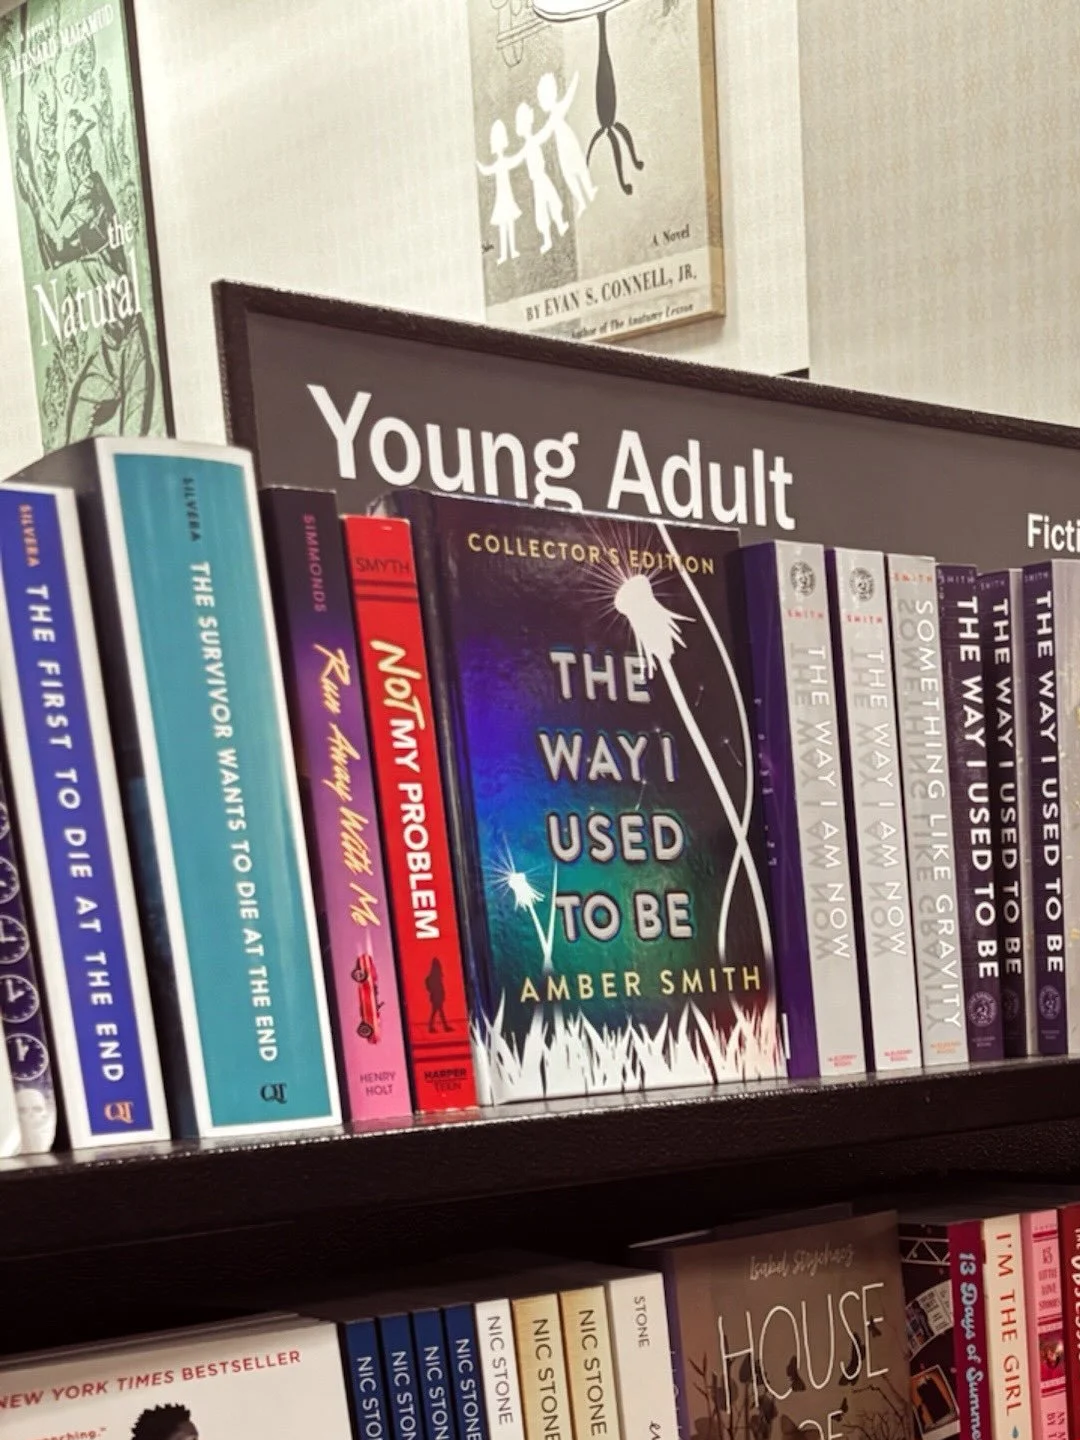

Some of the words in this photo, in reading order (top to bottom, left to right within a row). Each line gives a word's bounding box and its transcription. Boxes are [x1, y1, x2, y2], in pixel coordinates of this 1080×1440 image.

[108, 213, 132, 249] the
[651, 233, 658, 246] A
[663, 224, 690, 244] Novel
[32, 250, 141, 347] Natural
[526, 305, 540, 322] BY
[544, 292, 581, 317] EVAN
[585, 287, 599, 305] S.
[601, 268, 674, 301] CONNELL,
[308, 383, 583, 511] Young
[607, 429, 796, 530] Adult
[19, 504, 40, 568] SILVERA
[467, 532, 620, 566] COLLECTOR'S
[629, 547, 715, 577] EDITION
[189, 561, 215, 609] THE
[303, 514, 327, 613] SIMMONDS
[356, 557, 411, 574] SMYTH
[26, 585, 56, 643] THE
[198, 615, 234, 740] SURVIVOR
[313, 643, 350, 714] Run
[550, 650, 652, 704] THE
[914, 599, 947, 798] SOMETHING
[37, 660, 72, 749] FIRST
[322, 722, 361, 802] Away
[389, 718, 420, 773] MY
[538, 731, 648, 784] WAY
[661, 733, 677, 781] I
[54, 768, 81, 809] TO
[217, 748, 247, 832] WANTS
[64, 828, 93, 878] DIE
[230, 840, 252, 873] TO
[340, 806, 374, 876] With
[397, 782, 440, 939] PROBLEM
[545, 812, 686, 865] USED
[928, 813, 954, 883] LIKE
[75, 896, 101, 932] AT
[235, 881, 259, 920] DIE
[350, 882, 381, 927] Me
[555, 893, 624, 940] TO
[635, 892, 695, 940] BE
[242, 927, 264, 957] AT
[934, 893, 964, 1028] GRAVITY
[85, 952, 114, 1006] THE
[248, 966, 272, 1008] THE
[519, 974, 642, 1004] AMBER
[660, 965, 762, 994] SMITH
[95, 1023, 124, 1082] END
[255, 1014, 279, 1062] END
[360, 1071, 396, 1083] HENRY
[365, 1084, 393, 1096] HOLT
[995, 1232, 1013, 1278] I'M
[1000, 1294, 1018, 1341] THE
[717, 1282, 889, 1414] HOUSE
[52, 1381, 108, 1401] YORK
[117, 1370, 175, 1391] TIMES
[180, 1350, 302, 1382] BESTSELLER
[1002, 1354, 1023, 1416] GIRL
